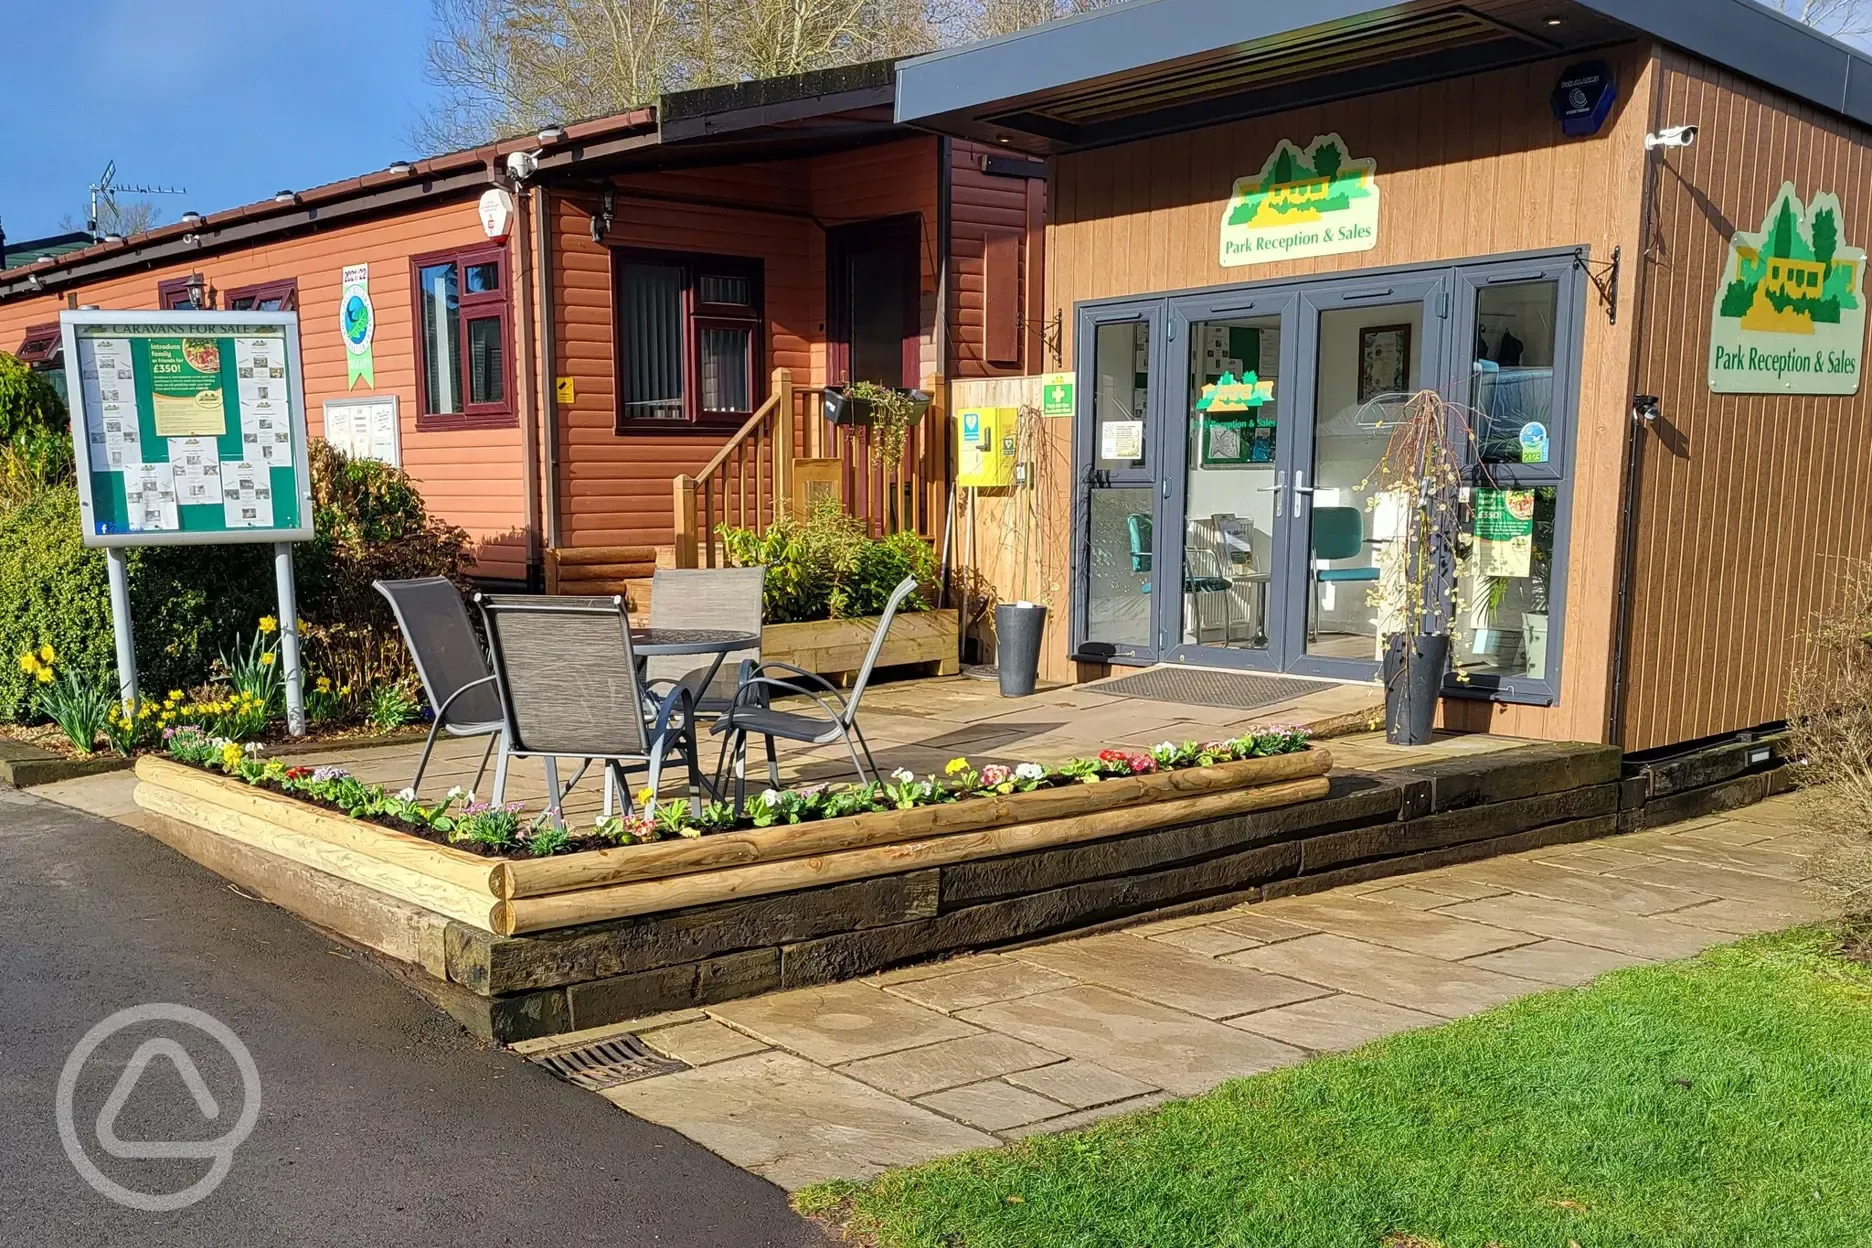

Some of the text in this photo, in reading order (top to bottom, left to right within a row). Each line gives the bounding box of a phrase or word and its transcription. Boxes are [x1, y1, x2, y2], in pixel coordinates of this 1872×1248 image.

[1225, 224, 1371, 254] Park Reception & Sales
[113, 324, 250, 334] CARAVANS FOR SALE
[1715, 345, 1856, 379] Park Reception & Sales
[153, 364, 181, 373] £350!
[1248, 420, 1255, 428] &
[1256, 417, 1277, 428] Sales
[1523, 452, 1541, 461] 2023
